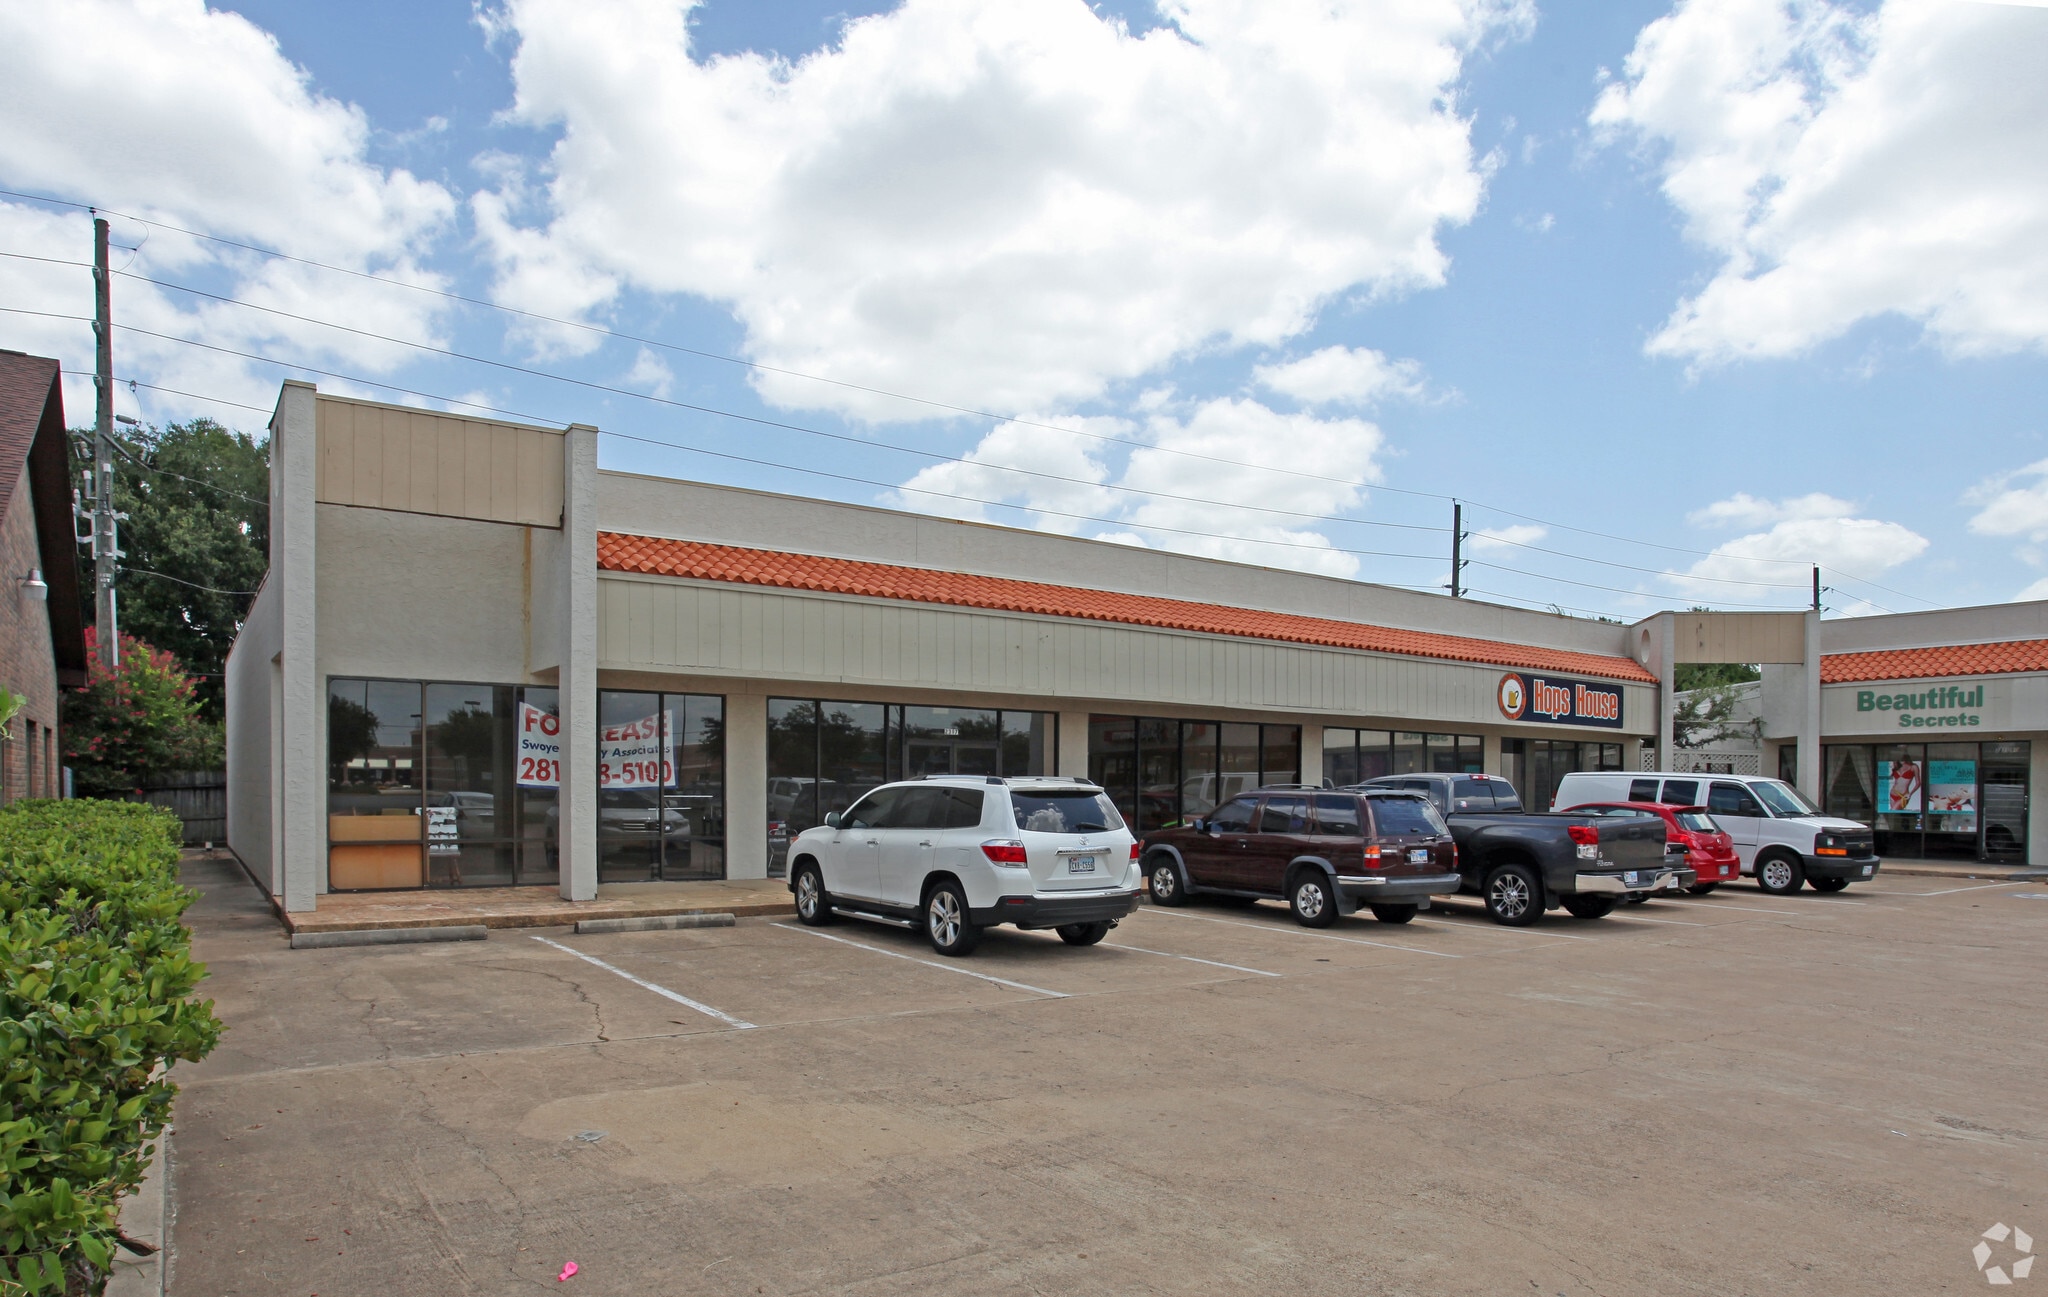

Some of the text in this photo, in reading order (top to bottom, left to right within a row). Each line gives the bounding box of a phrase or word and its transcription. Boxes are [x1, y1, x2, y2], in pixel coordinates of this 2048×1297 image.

[1534, 679, 1570, 719] Hops
[1576, 684, 1618, 719] House
[1857, 685, 1983, 712] Beautiful
[525, 707, 669, 741] FO EASE
[1899, 712, 1980, 727] Secrets
[522, 739, 559, 754] Swoye
[612, 745, 671, 757] Associats
